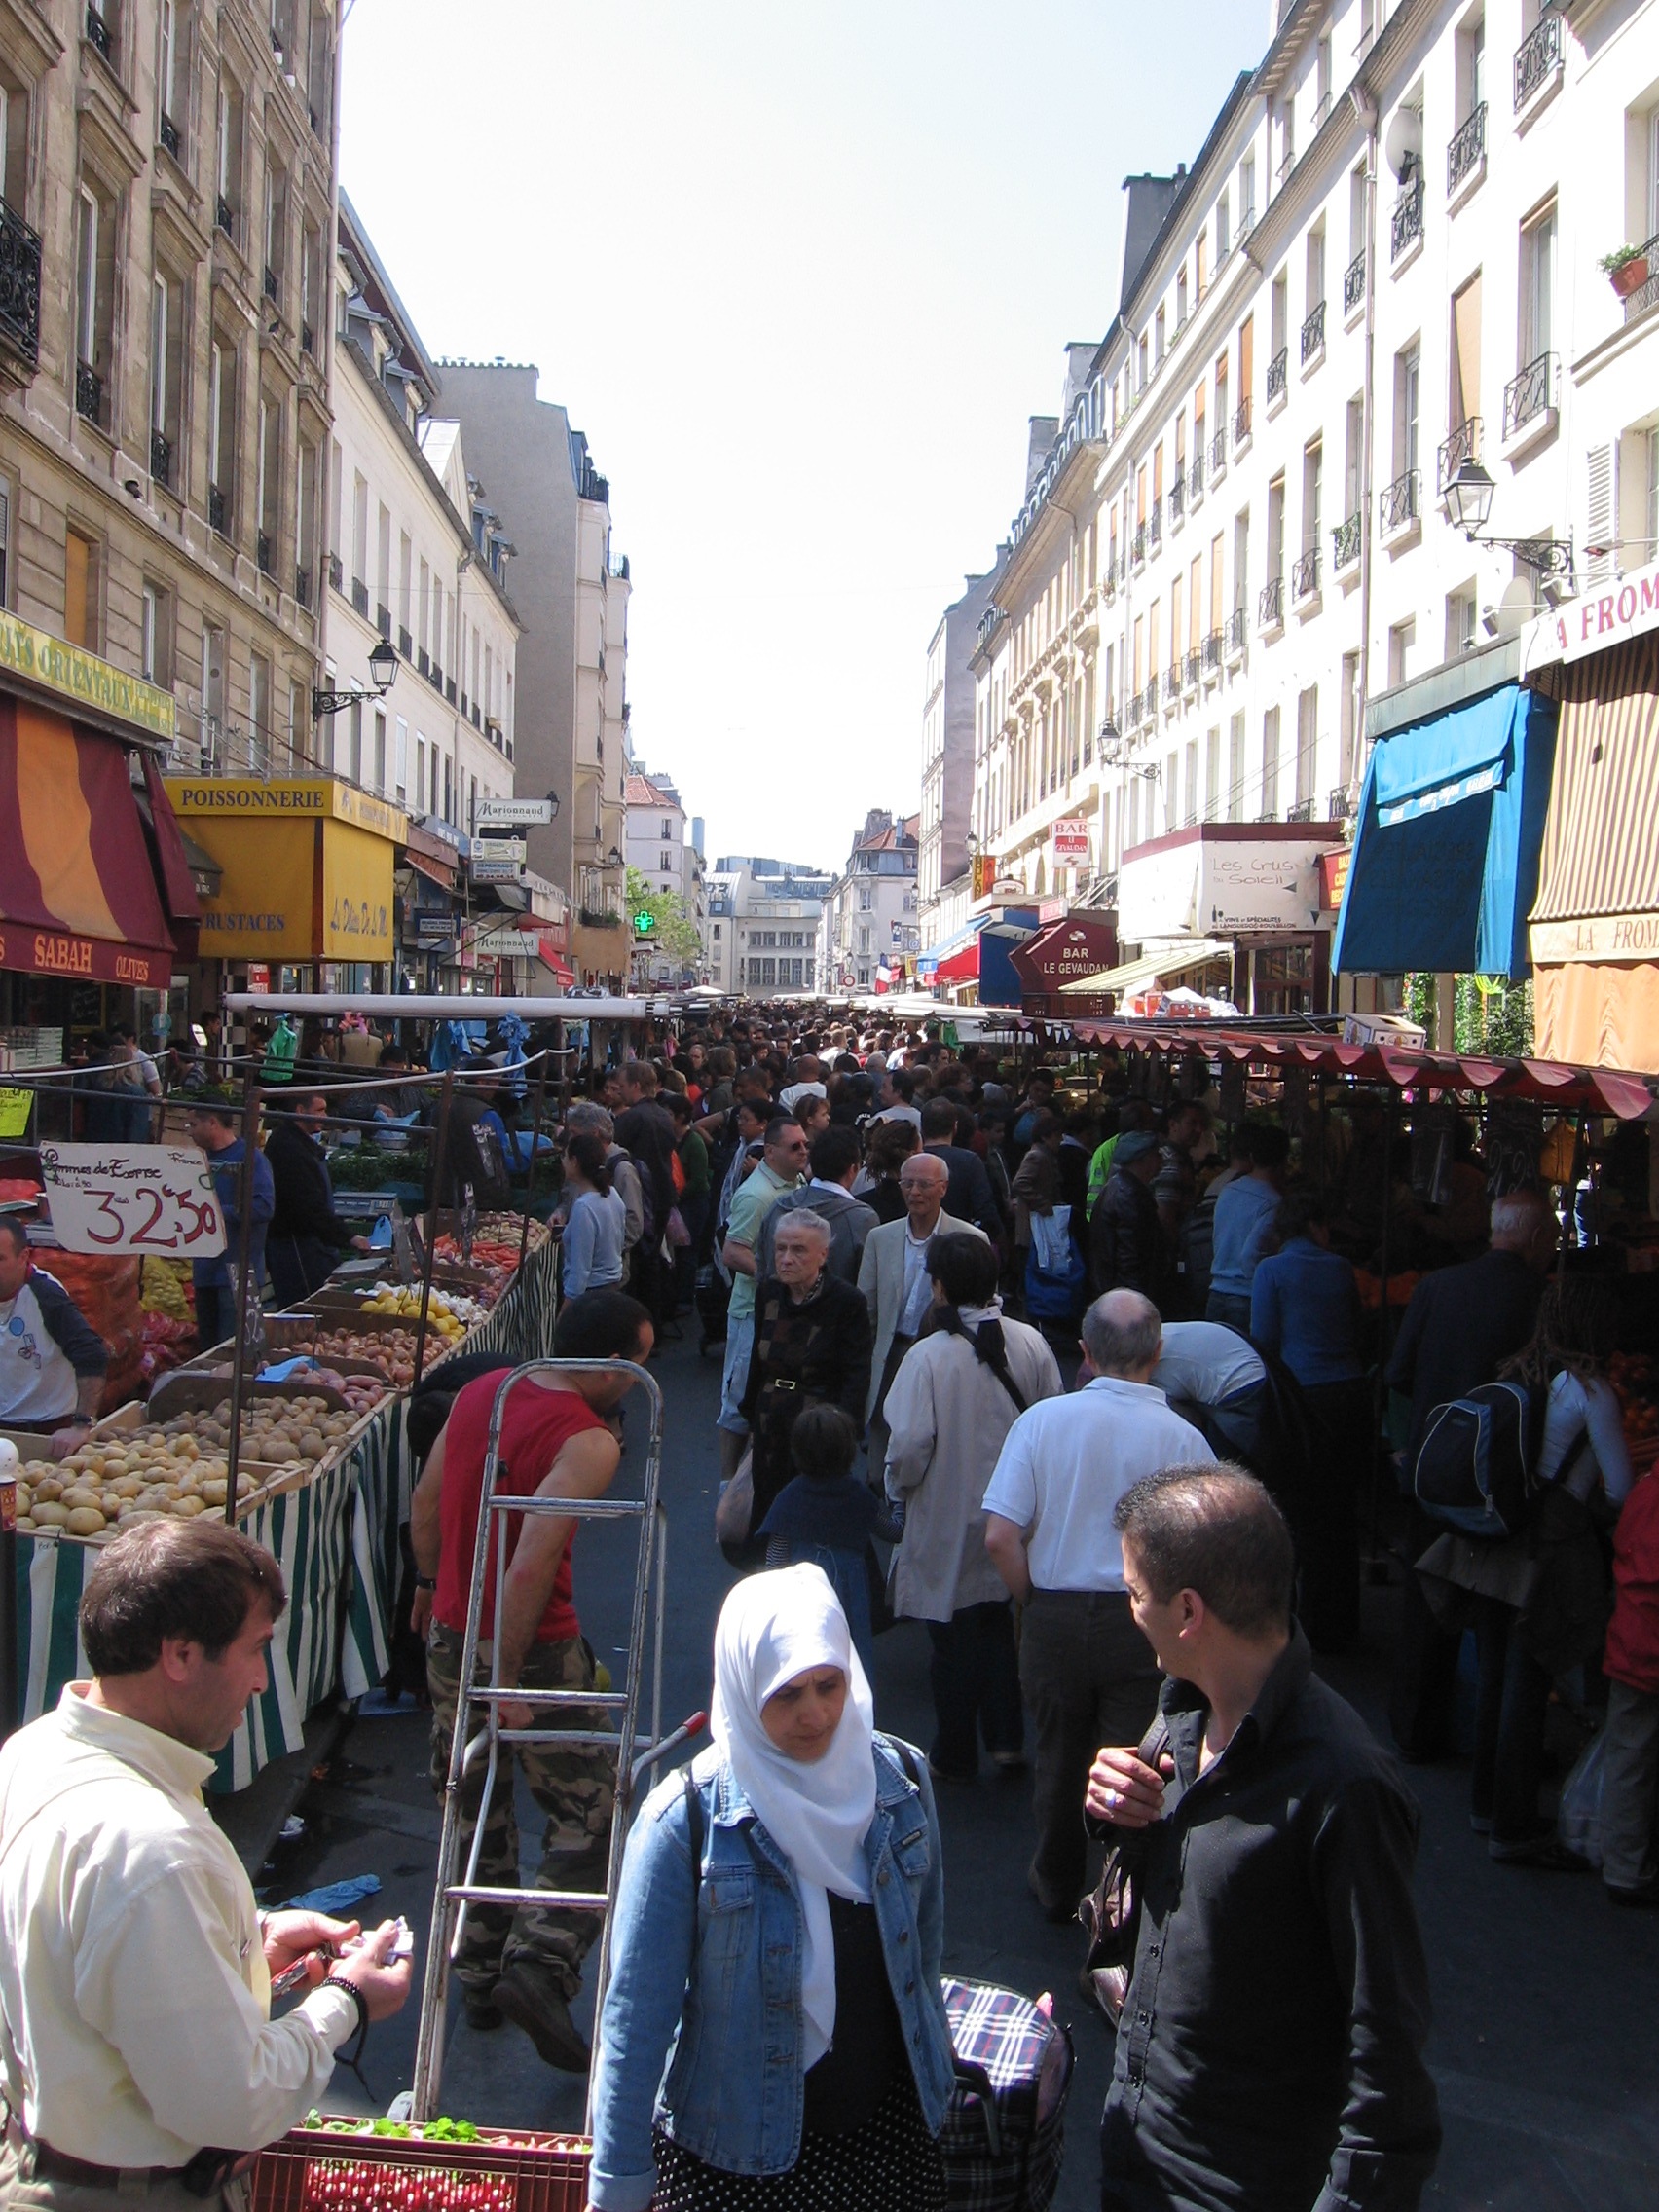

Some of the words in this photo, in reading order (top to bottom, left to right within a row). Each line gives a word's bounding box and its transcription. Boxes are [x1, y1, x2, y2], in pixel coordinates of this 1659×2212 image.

[182, 789, 324, 808] POISSONNERIE
[476, 801, 543, 818] Marionnaud
[1055, 823, 1088, 833] BAR
[1213, 858, 1242, 872] Les
[1251, 858, 1294, 872] Crus
[1229, 873, 1283, 885] Soleil
[202, 911, 286, 932] RUSTACES
[477, 935, 535, 948] Marionnaud
[1576, 925, 1594, 951] LA
[1612, 919, 1659, 950] FROM
[34, 933, 93, 974] SABAH
[116, 955, 149, 982] OLIVES
[1062, 948, 1089, 959] BAR
[1043, 963, 1055, 974] LE
[1058, 963, 1109, 975] GEVAUDAN
[93, 1161, 109, 1174] de
